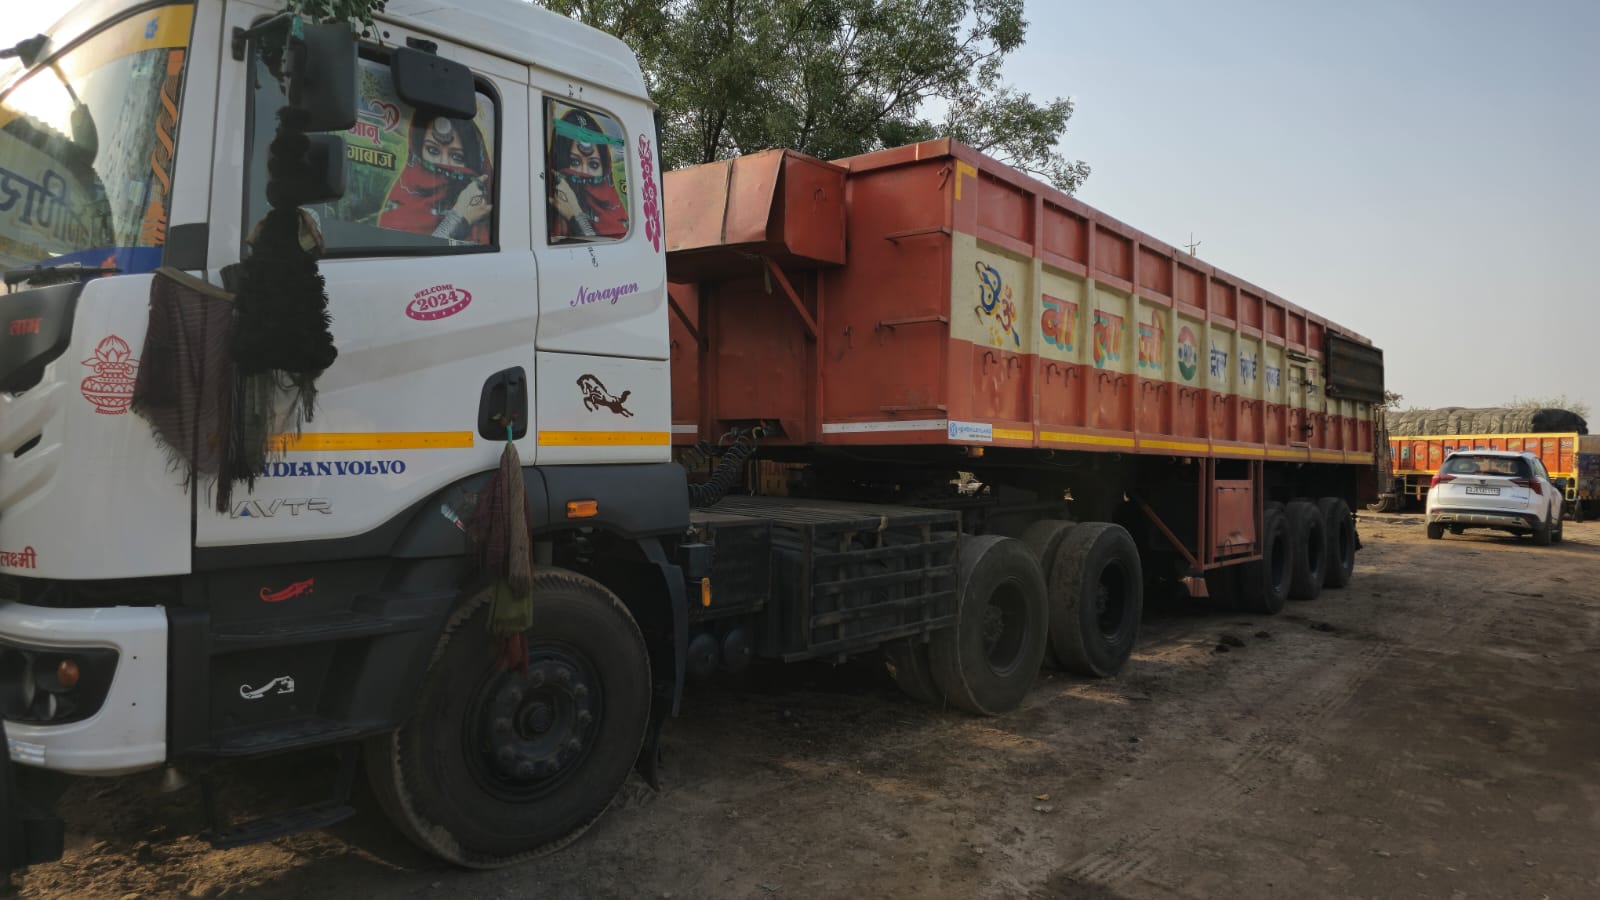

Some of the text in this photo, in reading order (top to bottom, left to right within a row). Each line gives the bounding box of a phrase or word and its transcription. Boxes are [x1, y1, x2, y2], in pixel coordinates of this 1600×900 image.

[346, 144, 393, 168] गाबाज
[414, 284, 453, 299] WELCOME
[416, 290, 459, 311] 2024
[570, 282, 639, 307] Narayan
